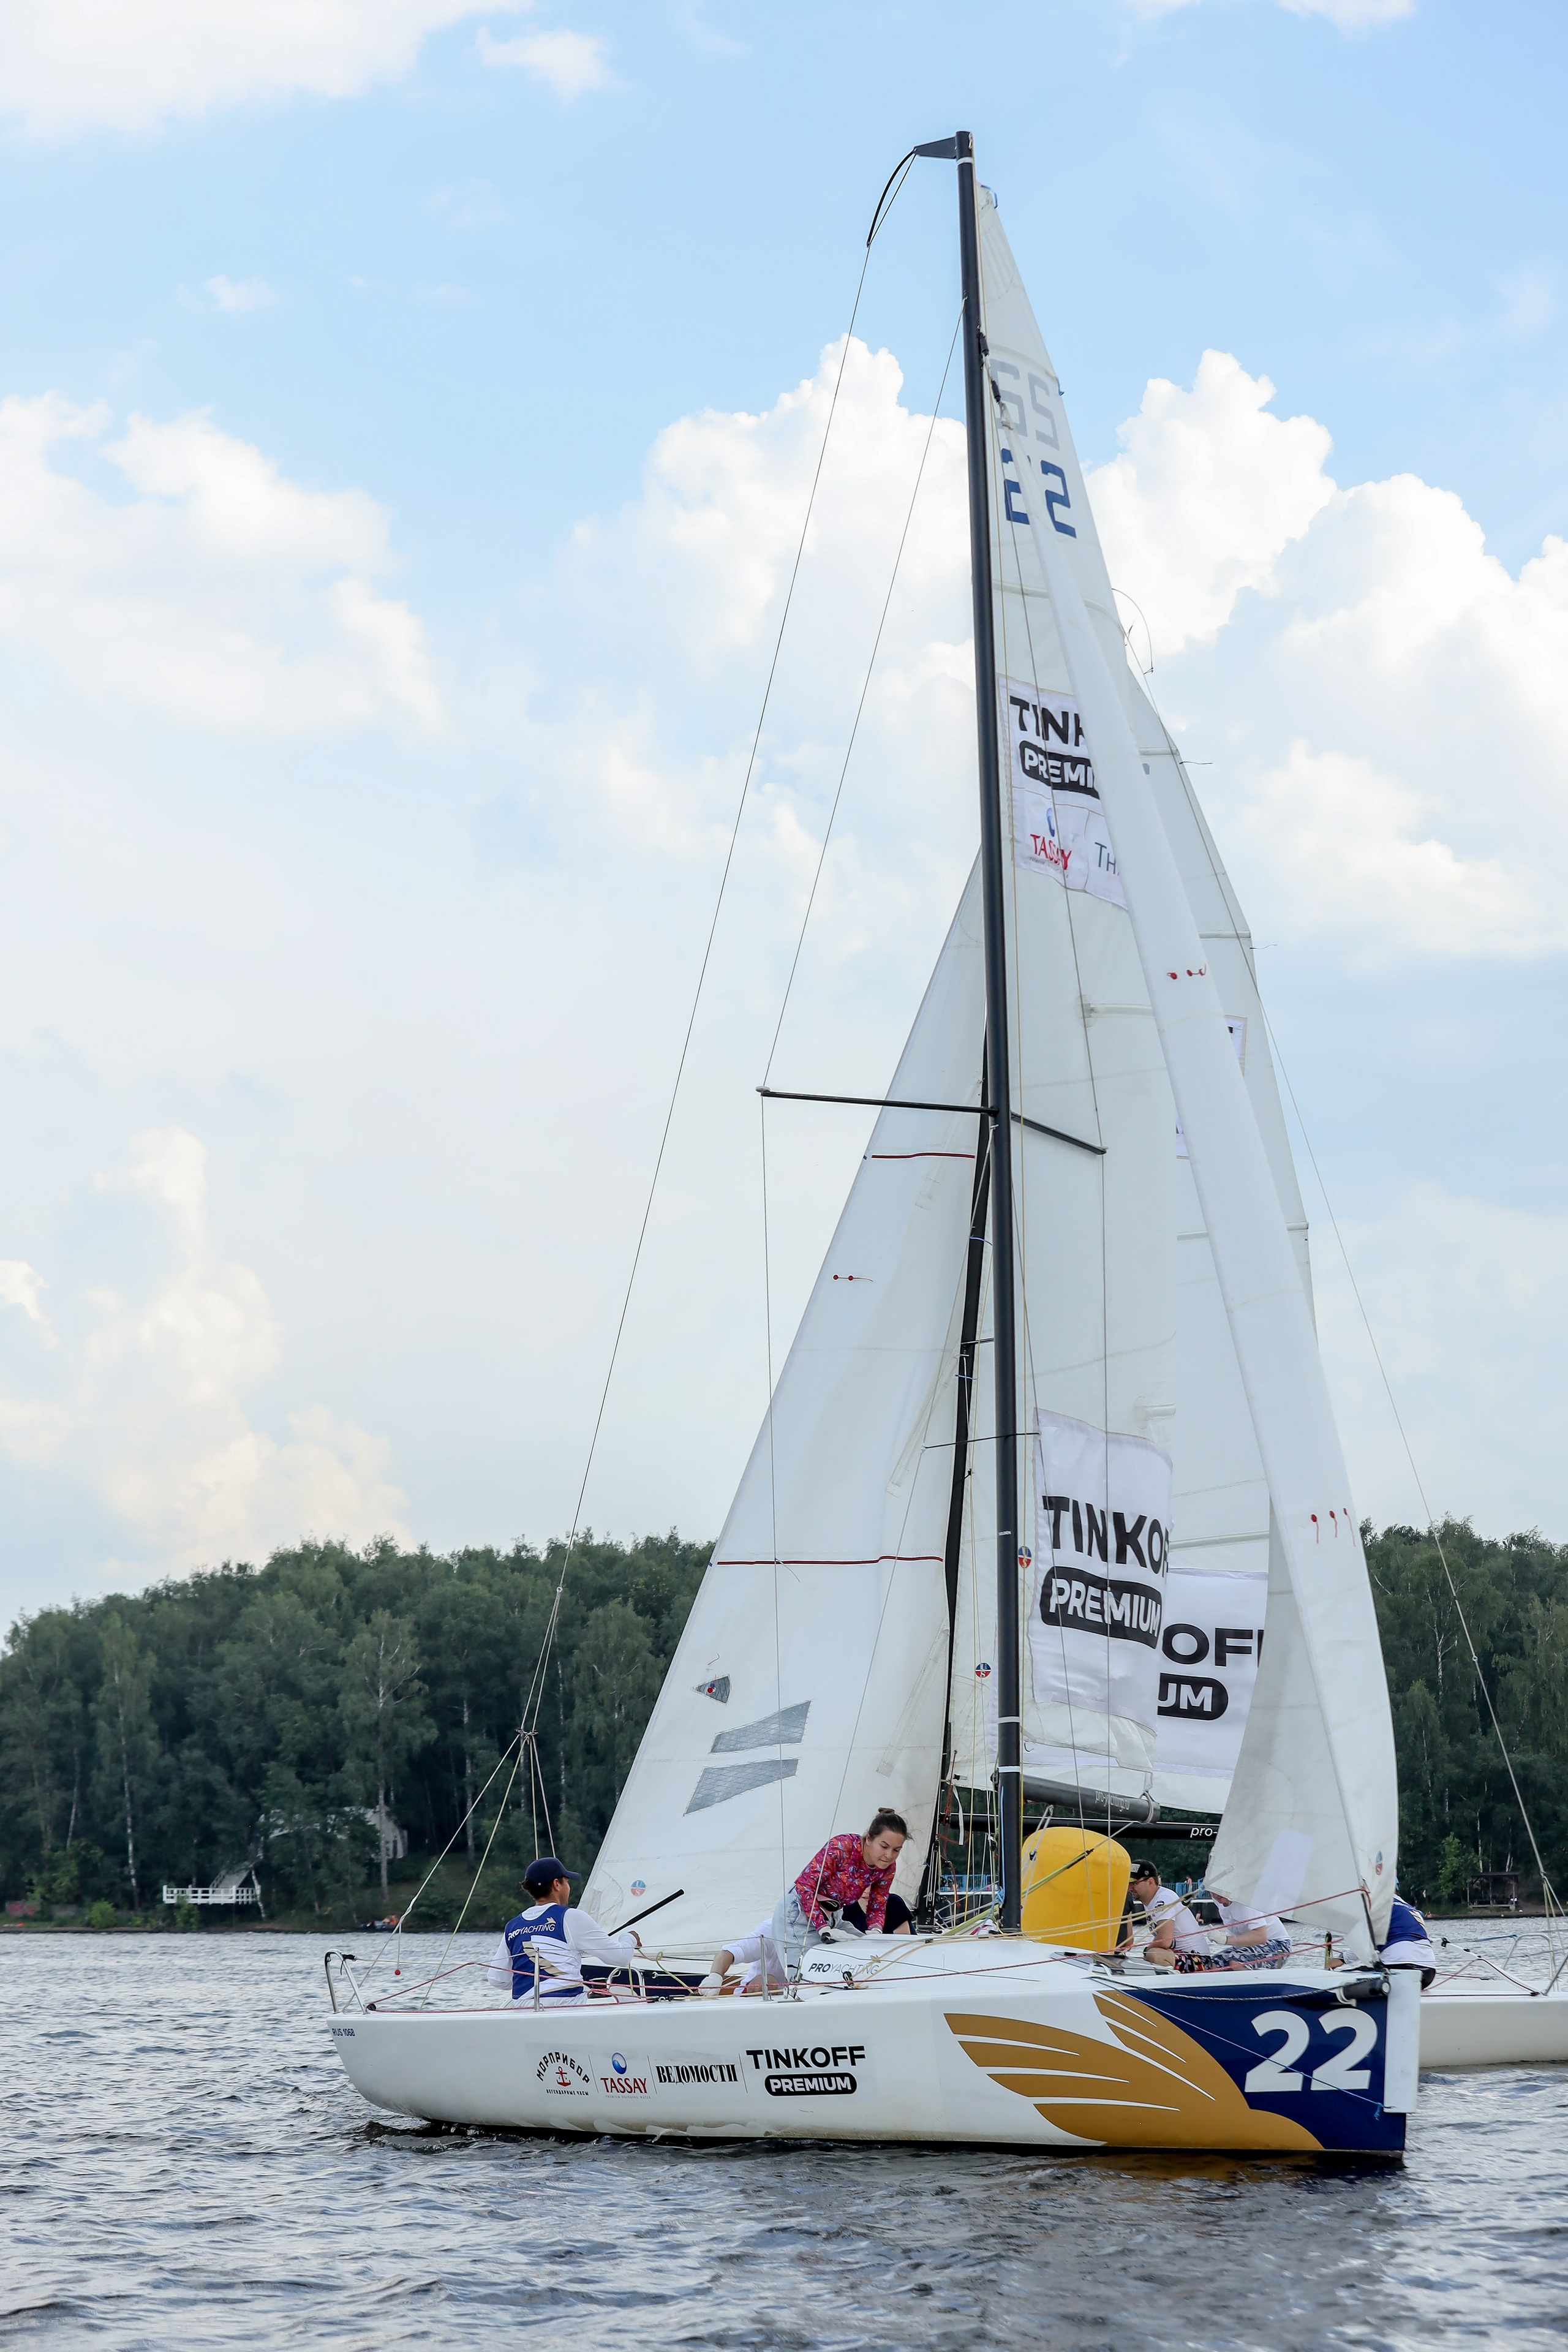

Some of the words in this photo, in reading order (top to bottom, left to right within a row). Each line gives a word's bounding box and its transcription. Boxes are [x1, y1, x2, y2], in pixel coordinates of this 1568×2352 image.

[1094, 841, 1120, 875] TH
[1049, 1578, 1161, 1638] PREMIUM
[1162, 1623, 1265, 1668] OF
[331, 2028, 343, 2037] RUS
[745, 2045, 865, 2070] TINKOFF
[1244, 2007, 1378, 2092] 22
[536, 2051, 590, 2084] МОРПРИБОР
[655, 2064, 738, 2085] ВЕДОМОСТИ
[600, 2077, 647, 2094] TASSAY
[769, 2077, 852, 2092] PREMIUM
